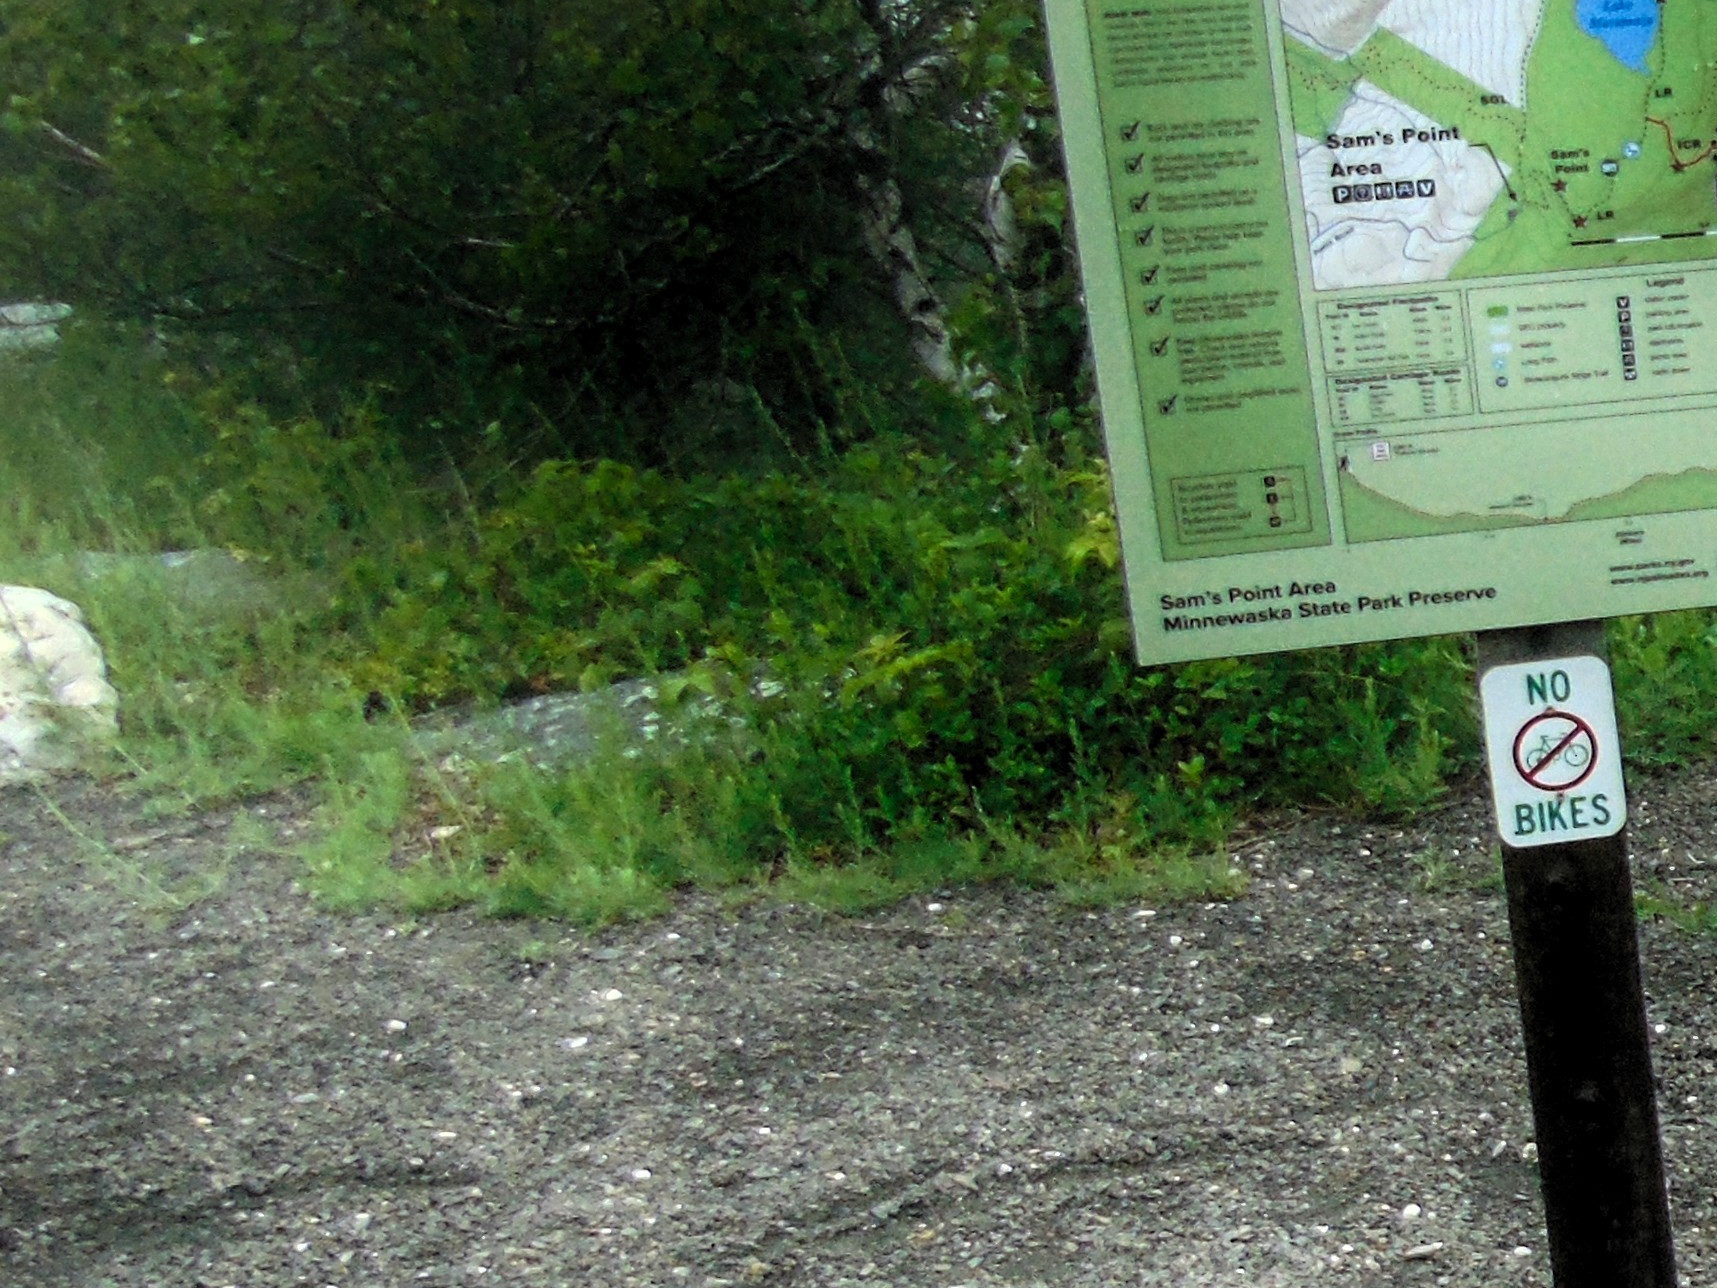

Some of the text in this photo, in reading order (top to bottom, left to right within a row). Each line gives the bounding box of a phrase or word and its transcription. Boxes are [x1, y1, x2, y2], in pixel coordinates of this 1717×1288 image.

[1655, 87, 1672, 97] LR
[1325, 124, 1461, 149] Sam's Point
[1550, 148, 1590, 161] Sam's
[1329, 160, 1382, 177] Area
[1554, 163, 1590, 174] Point
[1159, 578, 1336, 610] Sam's Point Area
[1162, 584, 1497, 632] Minnewaska State Park Preserve
[1526, 669, 1570, 705] NO
[1514, 793, 1611, 835] BIKES
